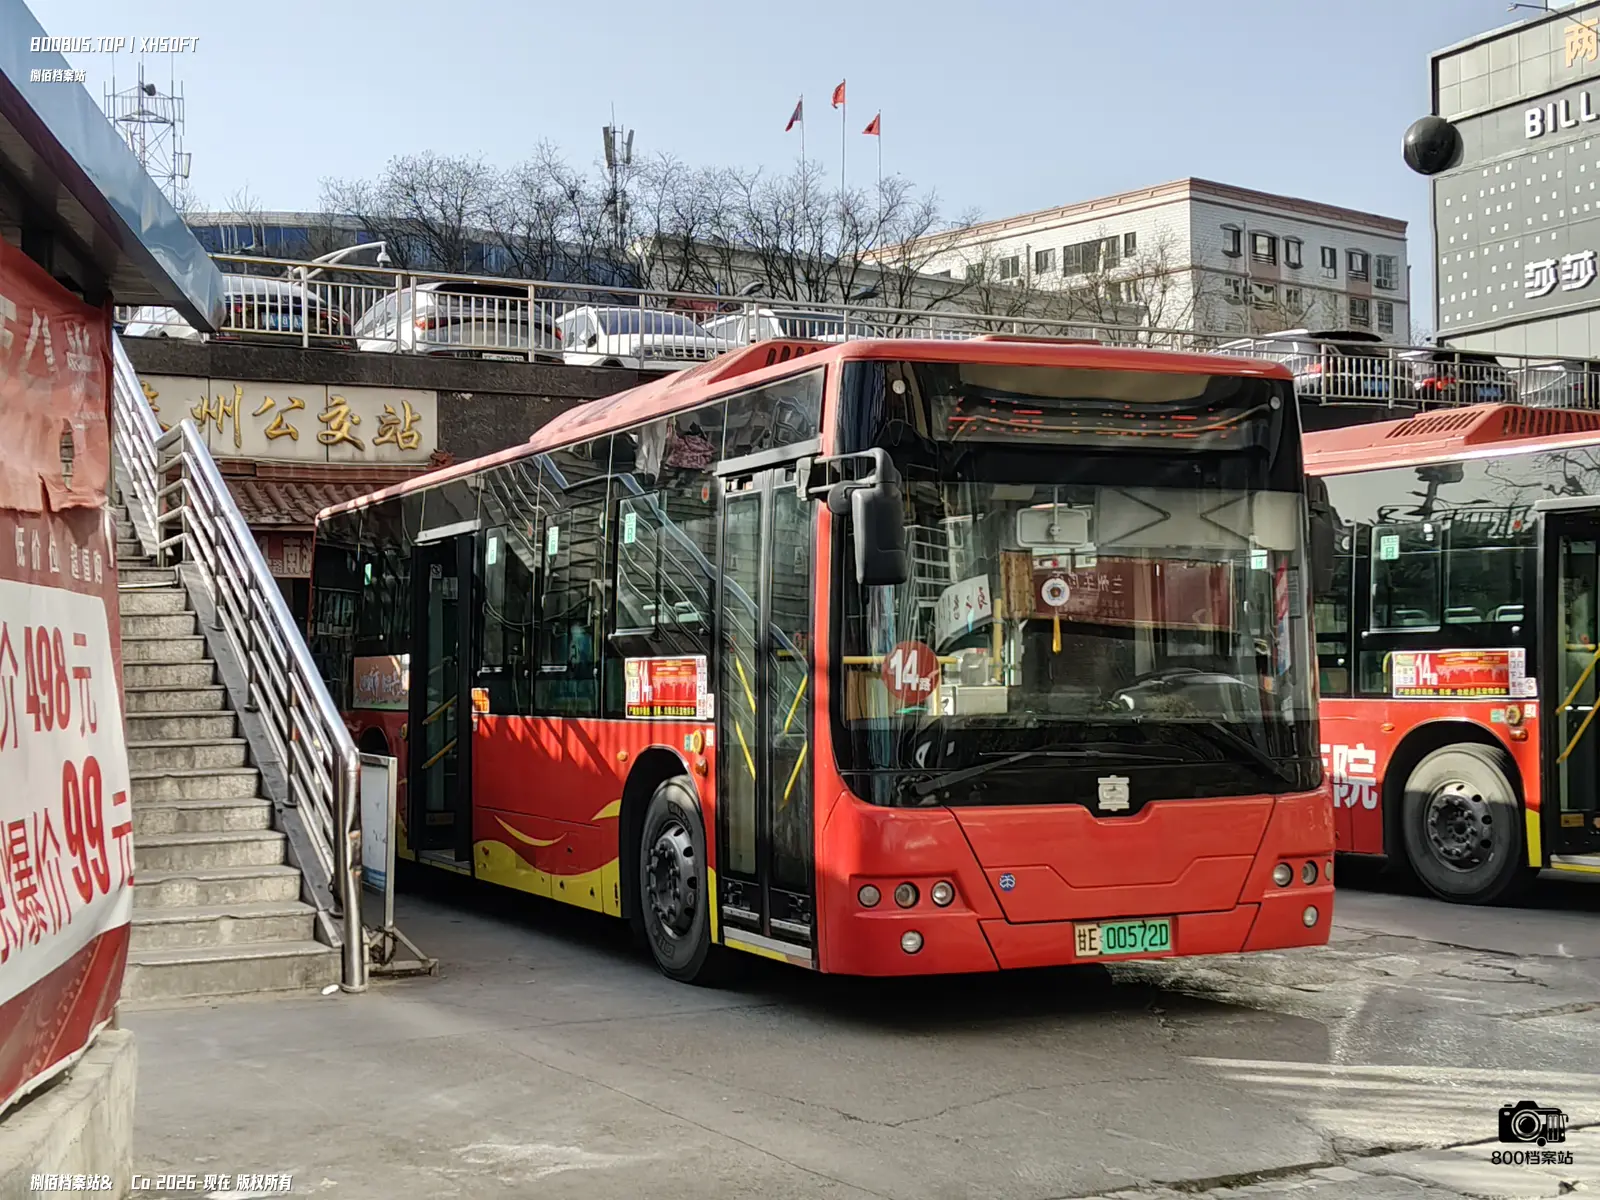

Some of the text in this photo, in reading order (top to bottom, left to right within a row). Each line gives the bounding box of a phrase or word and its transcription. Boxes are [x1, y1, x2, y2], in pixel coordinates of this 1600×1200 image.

[1525, 91, 1600, 139] BILL
[1524, 249, 1597, 299] 莎莎
[1320, 743, 1377, 809] 院
[0, 755, 135, 963] 爆价99元
